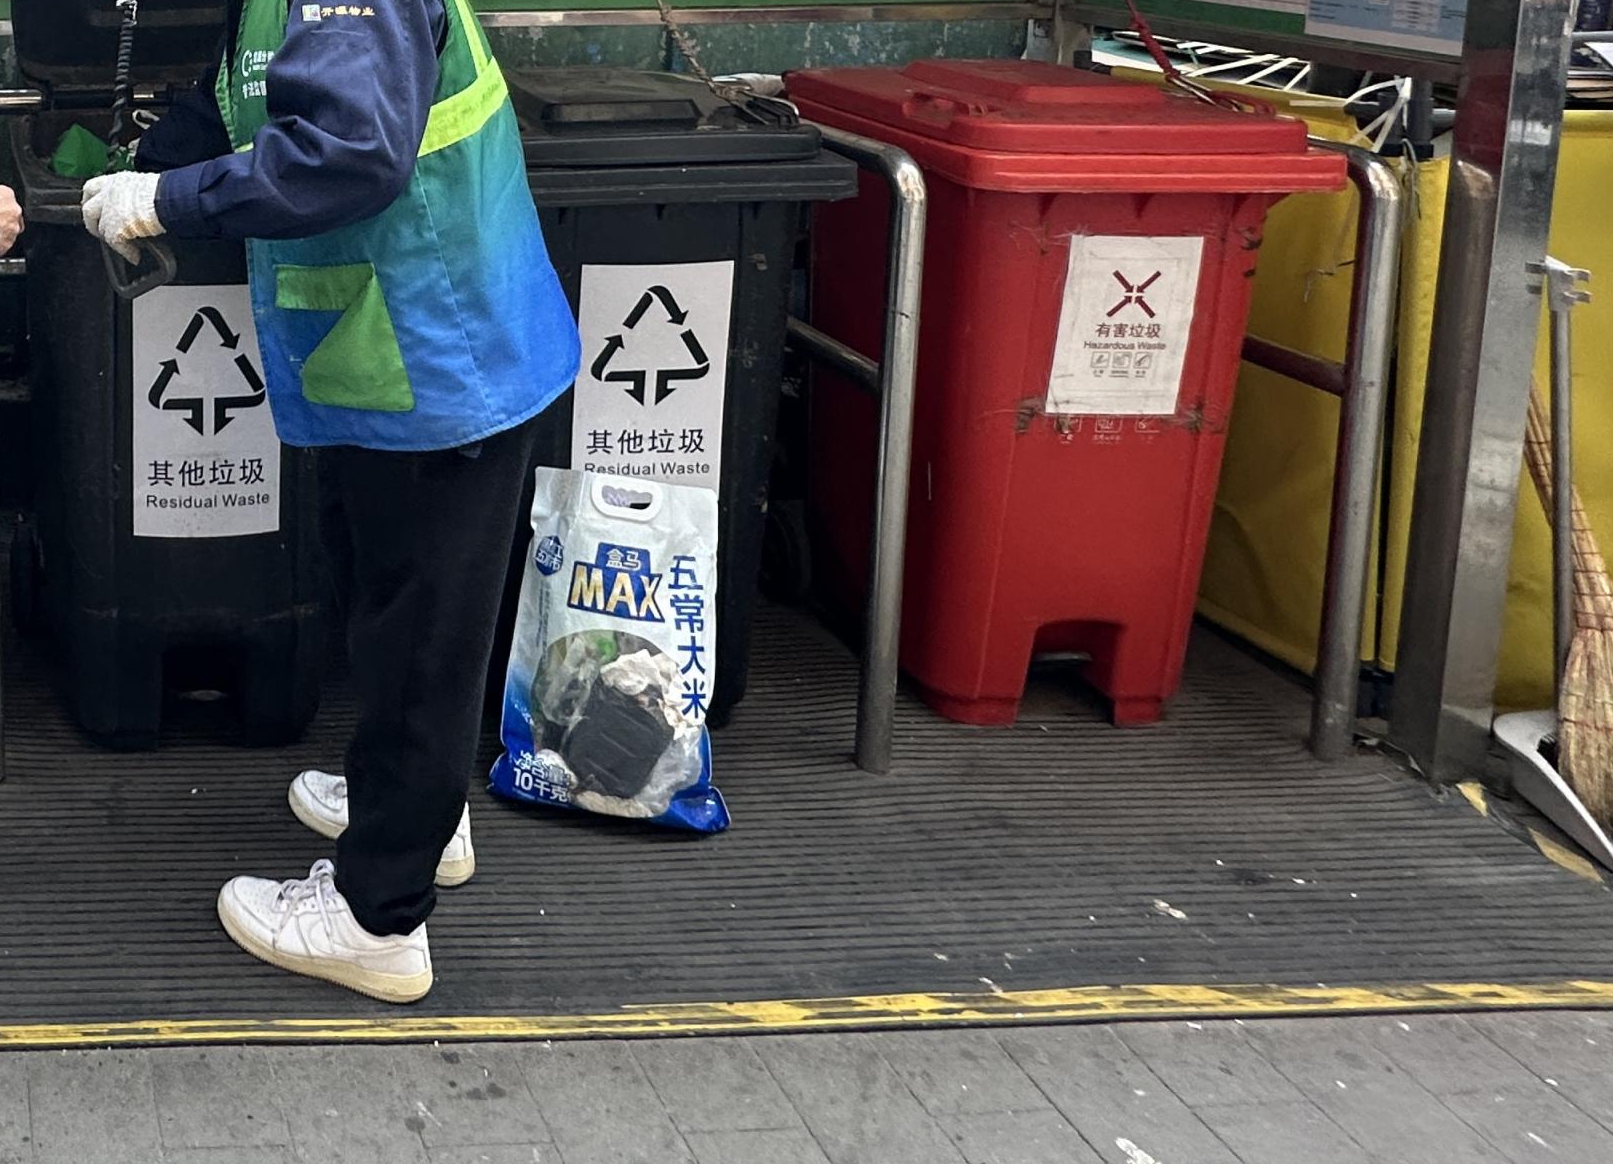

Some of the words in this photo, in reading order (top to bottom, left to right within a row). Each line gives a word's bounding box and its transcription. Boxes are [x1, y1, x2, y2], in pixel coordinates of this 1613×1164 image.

[1096, 323, 1161, 338] 有害垃圾
[1084, 340, 1135, 350] Hazardous
[1137, 342, 1166, 350] Waste
[586, 428, 705, 455] 其他垃圾
[148, 459, 265, 486] 其他垃圾
[585, 462, 656, 476] Residual
[660, 462, 710, 474] Waste
[146, 494, 217, 508] Residual
[222, 492, 270, 506] Waste
[606, 548, 641, 571] 盒马
[570, 565, 661, 619] MAX
[668, 555, 708, 719] 五常大米
[514, 768, 568, 802] 10千克
